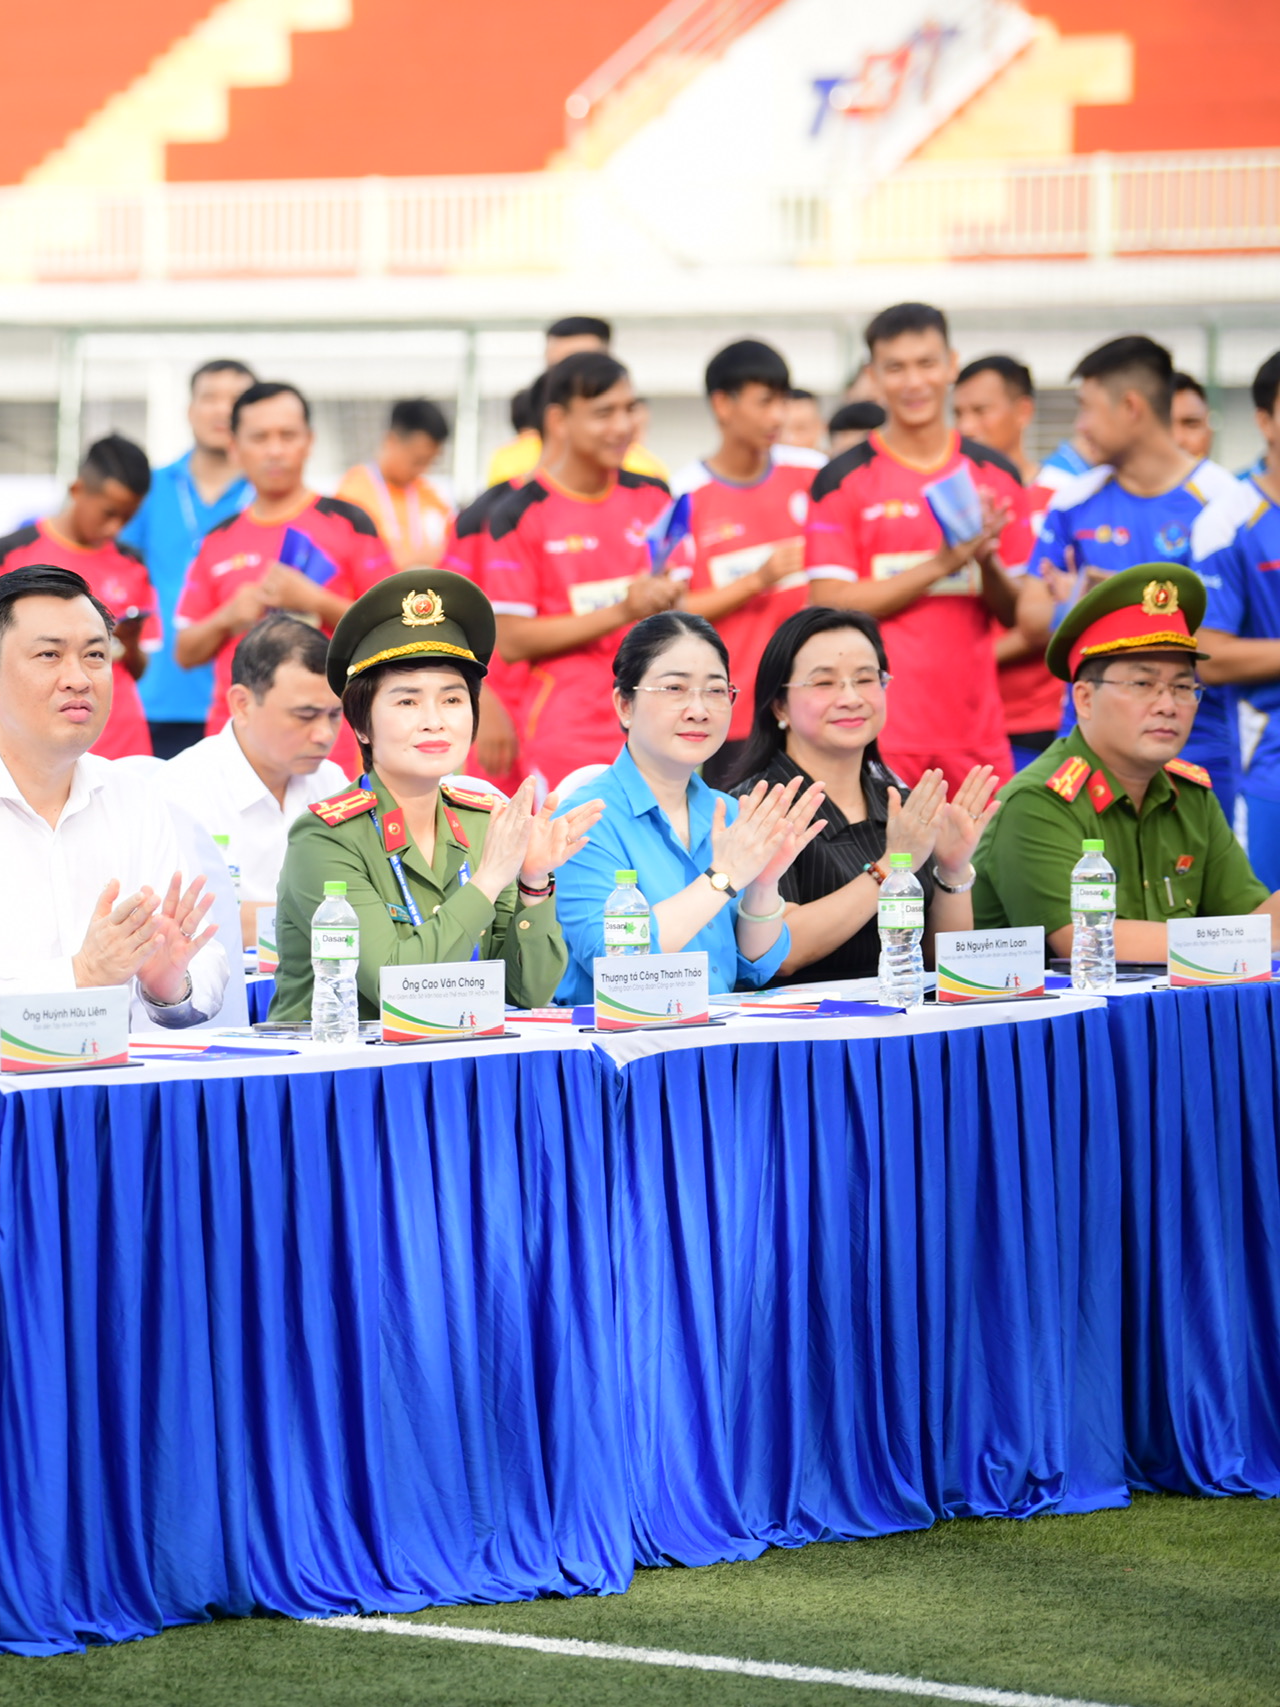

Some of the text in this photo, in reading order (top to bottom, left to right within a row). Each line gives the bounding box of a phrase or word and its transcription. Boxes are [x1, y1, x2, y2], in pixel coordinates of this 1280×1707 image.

[1196, 928, 1206, 938] Bà
[1221, 927, 1233, 936] Thu
[955, 938, 1027, 953] Bà Nguyễn Kim Loan
[601, 972, 629, 985] Thượng
[630, 971, 638, 981] tá
[639, 970, 659, 982] Công
[660, 968, 683, 980] Thanh
[402, 977, 420, 993] Ông
[421, 978, 439, 990] Cao
[440, 978, 457, 988] Văn
[22, 1008, 41, 1023] Ông
[87, 1006, 107, 1017] Liêm
